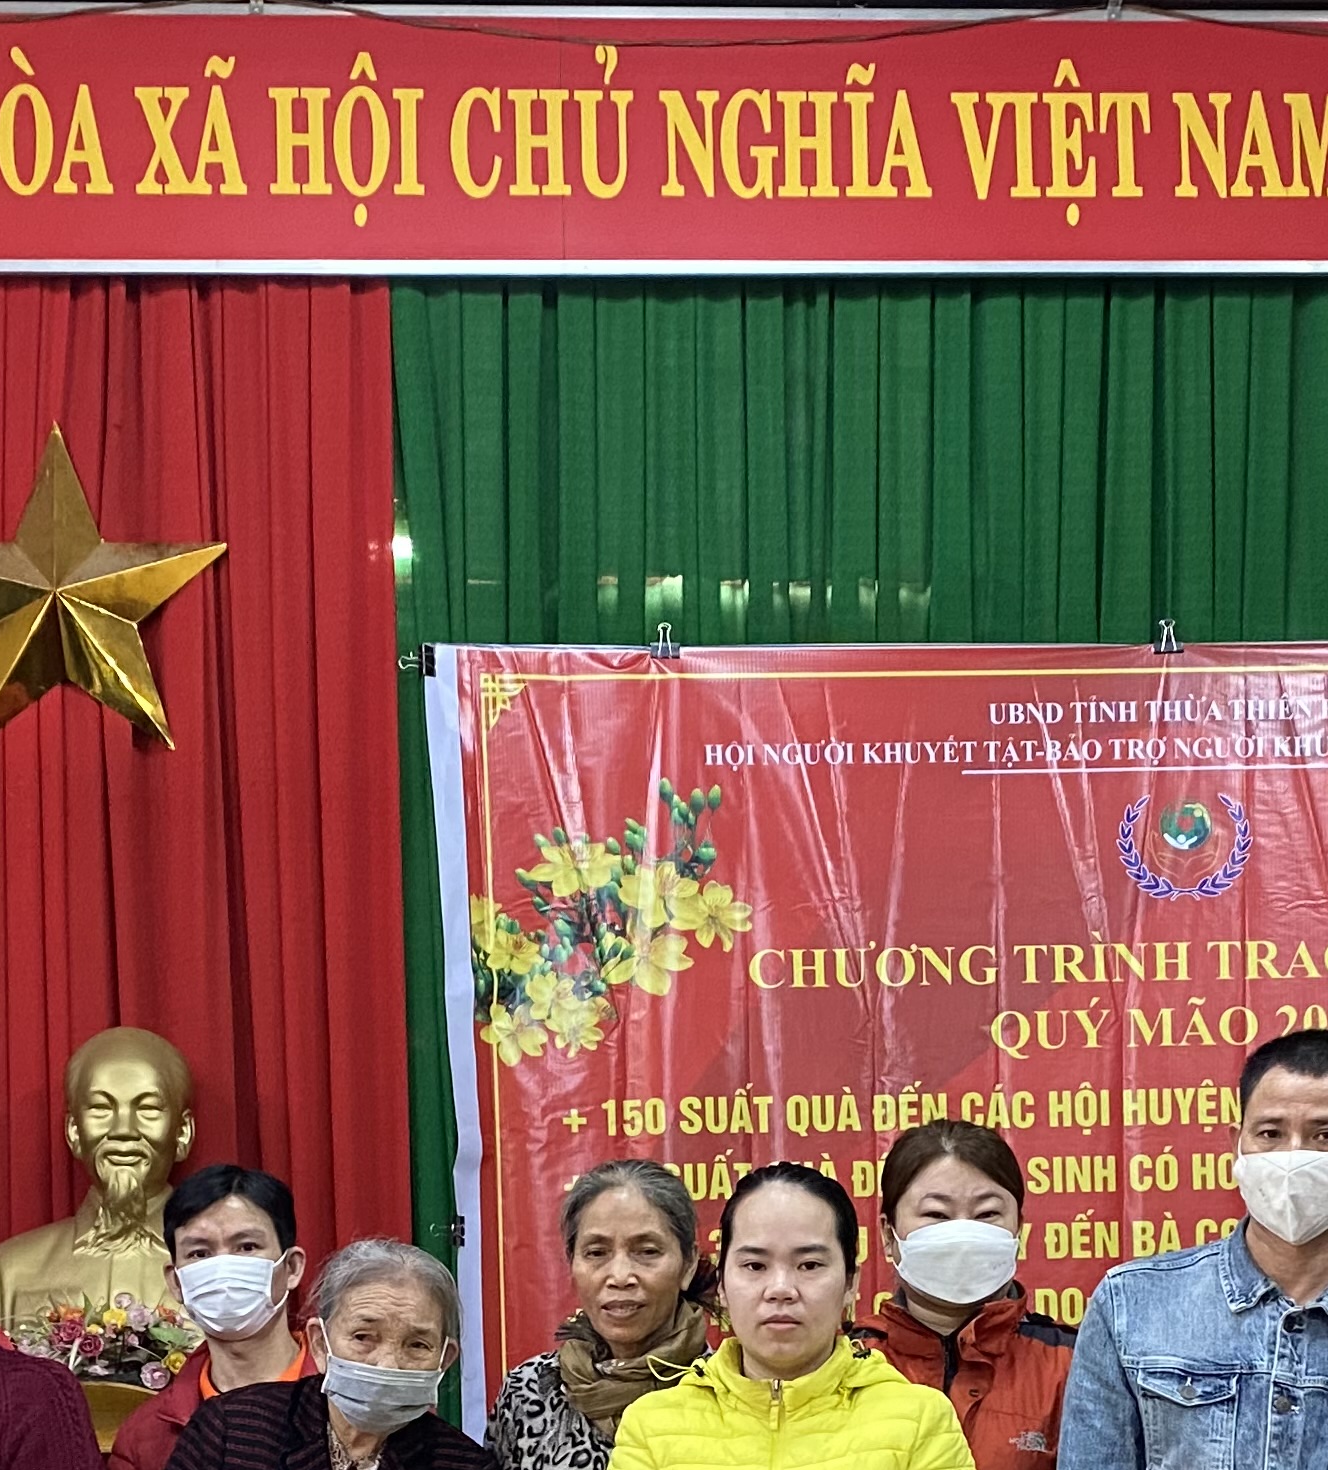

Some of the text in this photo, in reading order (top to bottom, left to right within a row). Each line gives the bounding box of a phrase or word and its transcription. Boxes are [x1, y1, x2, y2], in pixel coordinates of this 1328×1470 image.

[134, 54, 248, 197] XÃ
[267, 52, 426, 228] HỘI
[449, 44, 634, 200] CHỦ
[658, 62, 933, 201] NGHĨA
[949, 58, 1150, 228] VIỆT
[989, 701, 1065, 726] UBND
[1069, 694, 1138, 724] TỈNH
[1144, 692, 1223, 724] THỪA
[1228, 692, 1312, 721] THIÊN
[704, 740, 754, 767] HỘI
[762, 737, 855, 766] NGƯỜI
[862, 736, 977, 765] KHUYẾT
[1107, 736, 1167, 763] TRỢ
[748, 940, 1000, 990] CHƯƠNG
[1013, 931, 1192, 985] TRÌNH
[990, 997, 1111, 1060] QUÝ
[1126, 996, 1260, 1048] MÃO
[601, 1097, 667, 1137] 150
[679, 1082, 774, 1135] SUẤT
[785, 1086, 863, 1137] QUÀ
[872, 1080, 949, 1132] ĐẾN
[960, 1082, 1036, 1130] CÁC
[1047, 1081, 1111, 1136] HỘI
[1123, 1079, 1241, 1133] HUYỆN
[1026, 1154, 1117, 1195] SINH
[1129, 1145, 1180, 1193] CÓ
[1044, 1208, 1120, 1260] ĐẾN
[1132, 1211, 1182, 1258] BÀ
